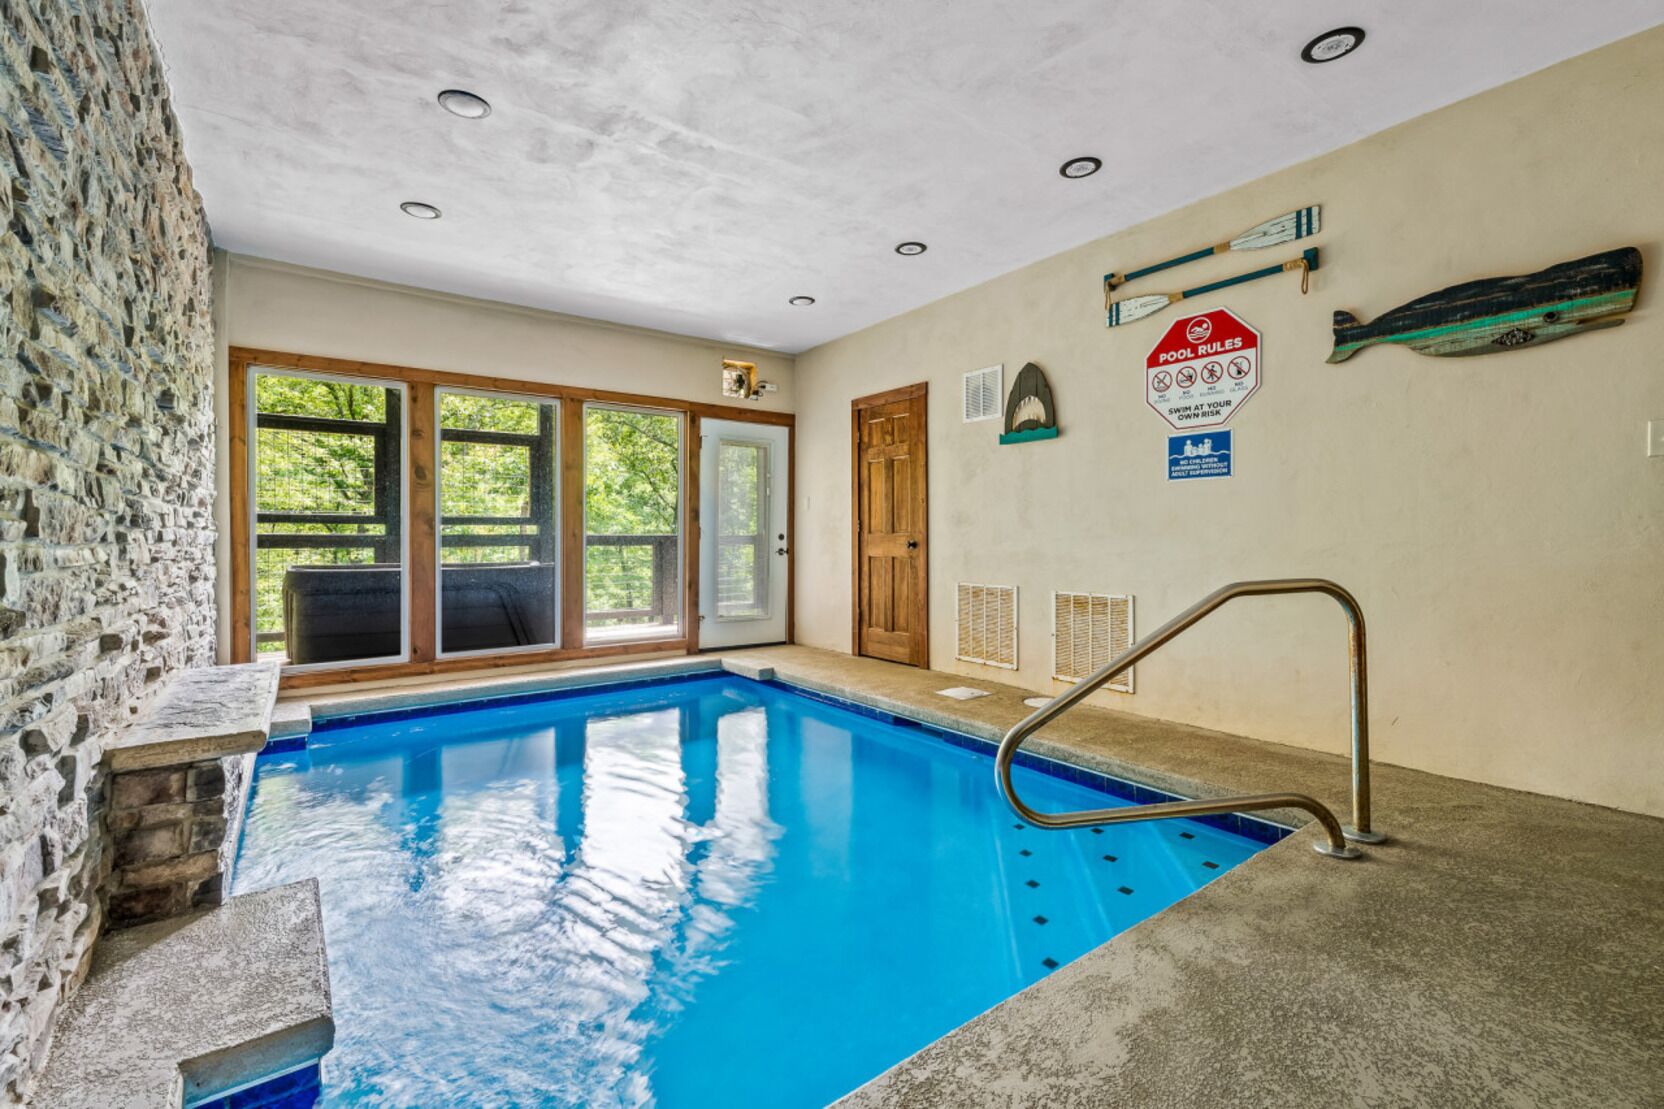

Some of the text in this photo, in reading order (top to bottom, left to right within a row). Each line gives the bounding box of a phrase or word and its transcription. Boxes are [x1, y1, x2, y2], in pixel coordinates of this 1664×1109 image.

[1159, 337, 1242, 363] POOL RULES
[1168, 405, 1191, 415] SWIM
[1207, 400, 1232, 409] YOUR
[1177, 409, 1221, 421] OWN RISK
